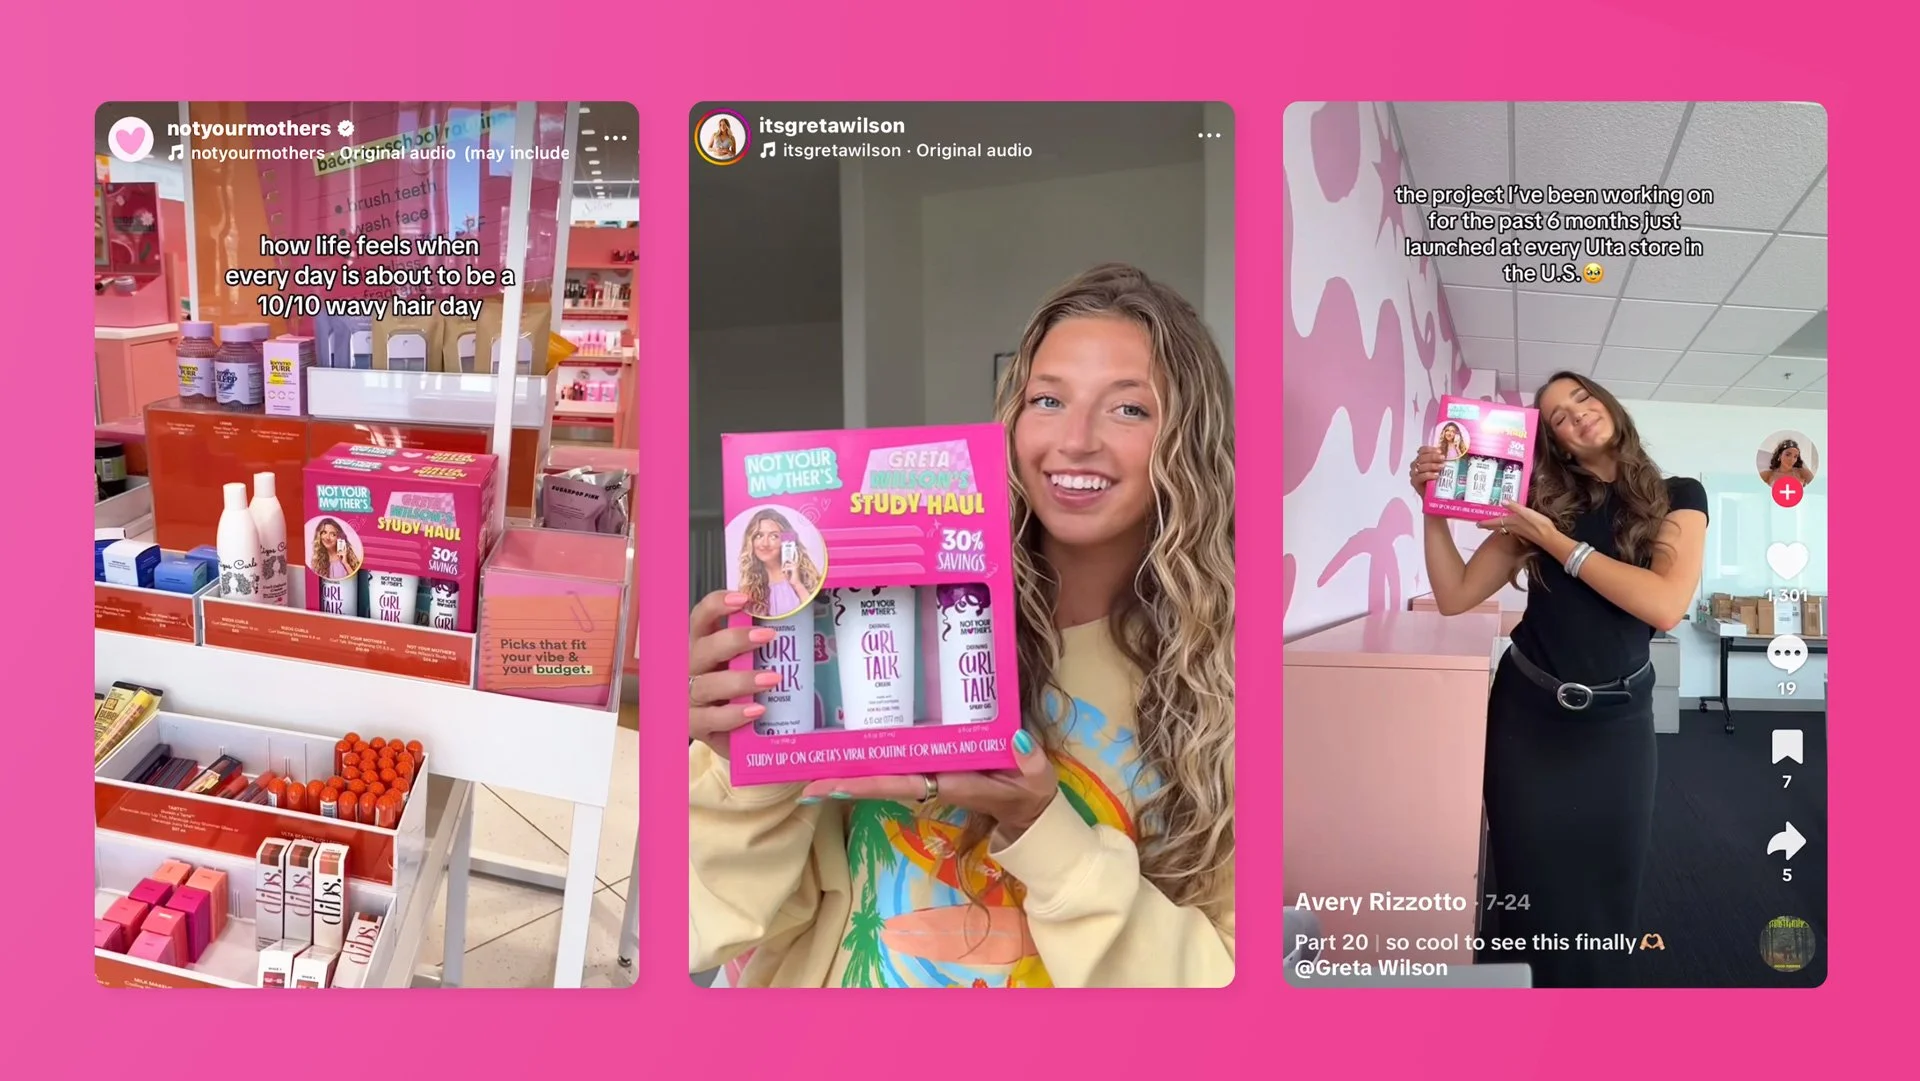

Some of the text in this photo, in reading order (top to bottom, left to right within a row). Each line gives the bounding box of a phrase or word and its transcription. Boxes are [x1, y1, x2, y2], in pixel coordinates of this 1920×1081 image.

[394, 179, 437, 201] teeth
[395, 207, 429, 225] face
[747, 451, 831, 474] NOT YOUR
[888, 450, 950, 469] GRETA
[870, 469, 970, 490] WILSON'S
[318, 486, 368, 498] NOT YOUR
[850, 492, 985, 516] STUDY HAUL
[377, 516, 461, 541] STUDY HAUL
[941, 529, 984, 551] 30%
[432, 546, 458, 562] 30%
[937, 553, 986, 572] SAVINGS
[429, 560, 458, 576] SAVINGS
[861, 600, 896, 609] NOT YOUR
[960, 619, 991, 628] NOT YOUR
[501, 638, 587, 650] Picks that fit
[501, 652, 579, 664] your vibe &
[502, 664, 591, 677] your budget.
[863, 655, 901, 681] TALK
[960, 676, 996, 703] TALK
[746, 738, 1007, 768] STUDY UP ON GRETA'S VIRAL ROUTINE FOR WAVES AND CURLS!
